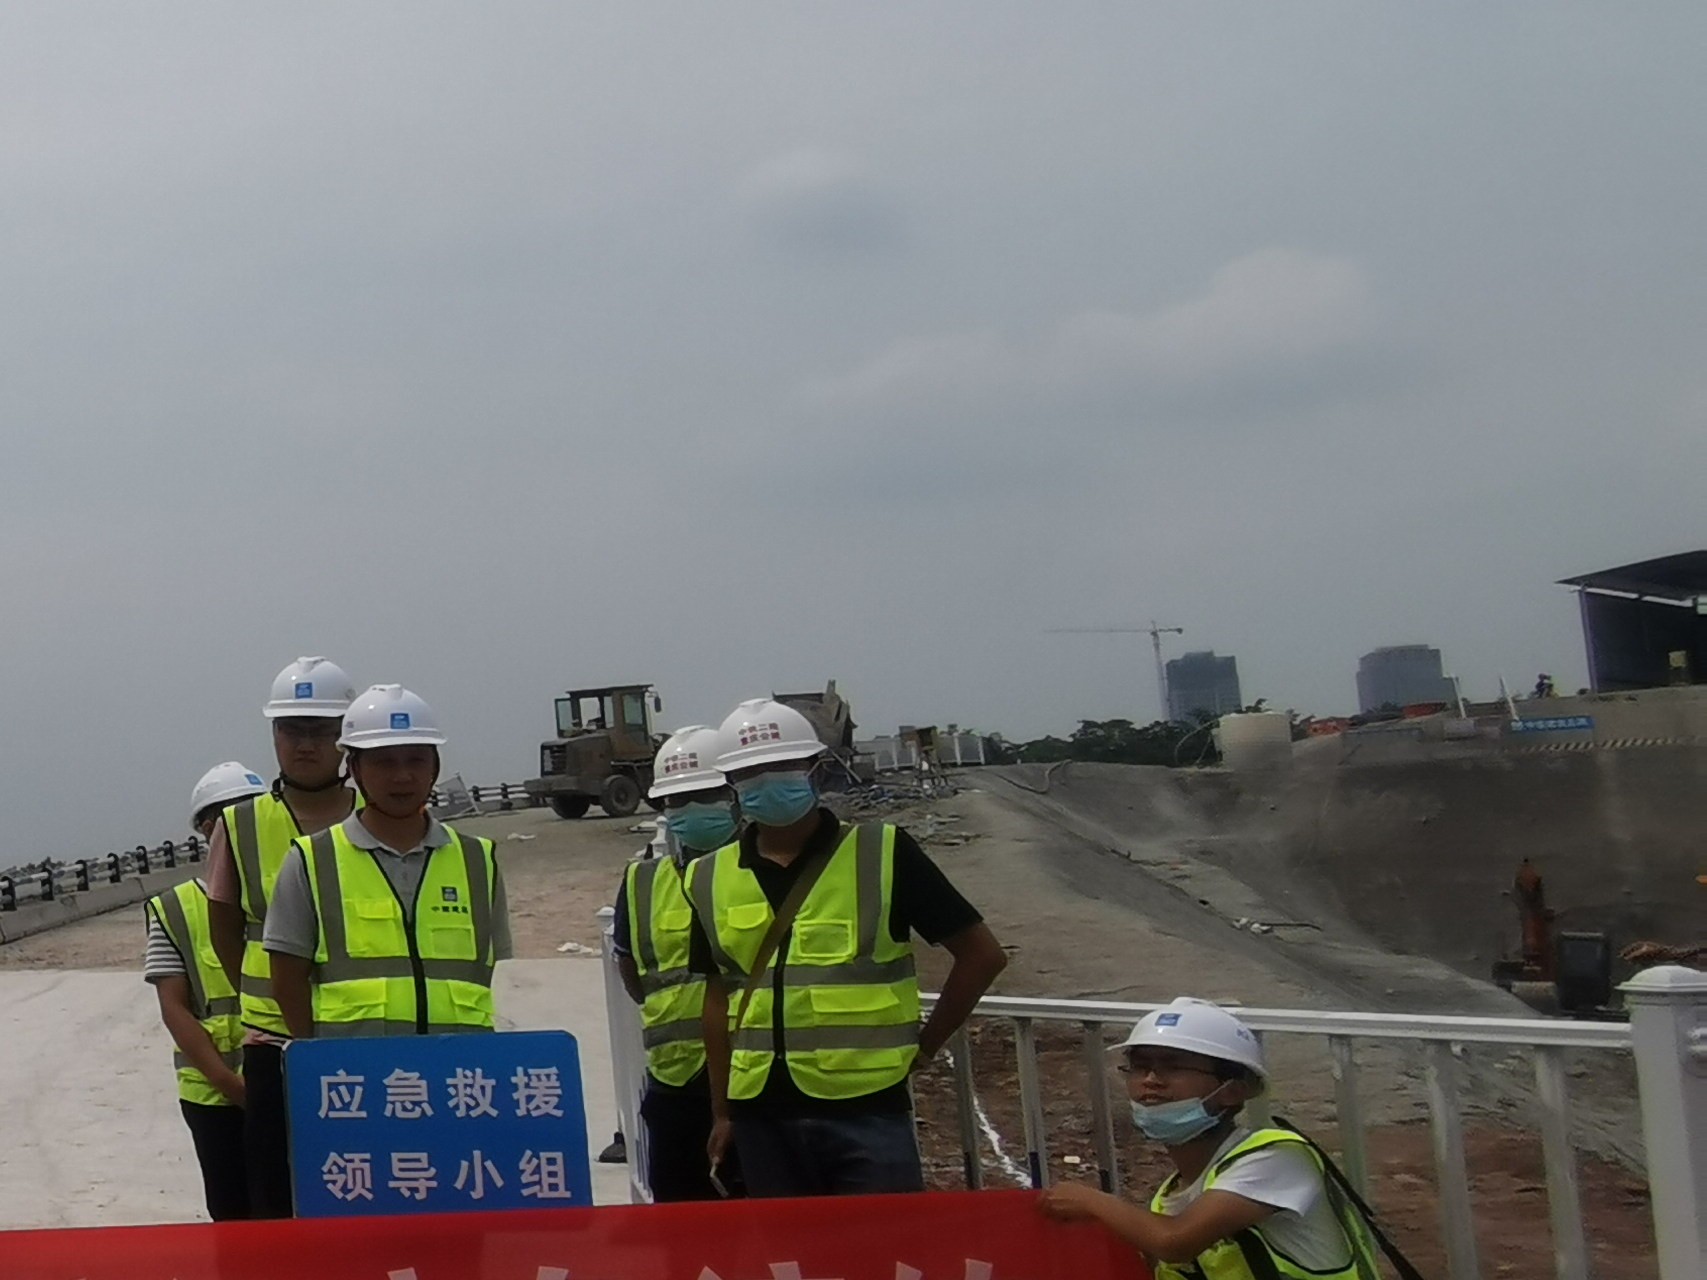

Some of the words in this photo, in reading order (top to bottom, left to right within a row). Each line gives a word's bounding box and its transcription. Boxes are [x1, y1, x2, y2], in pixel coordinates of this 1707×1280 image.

[318, 1066, 564, 1119] 应急救援
[322, 1151, 572, 1202] 领导小组
